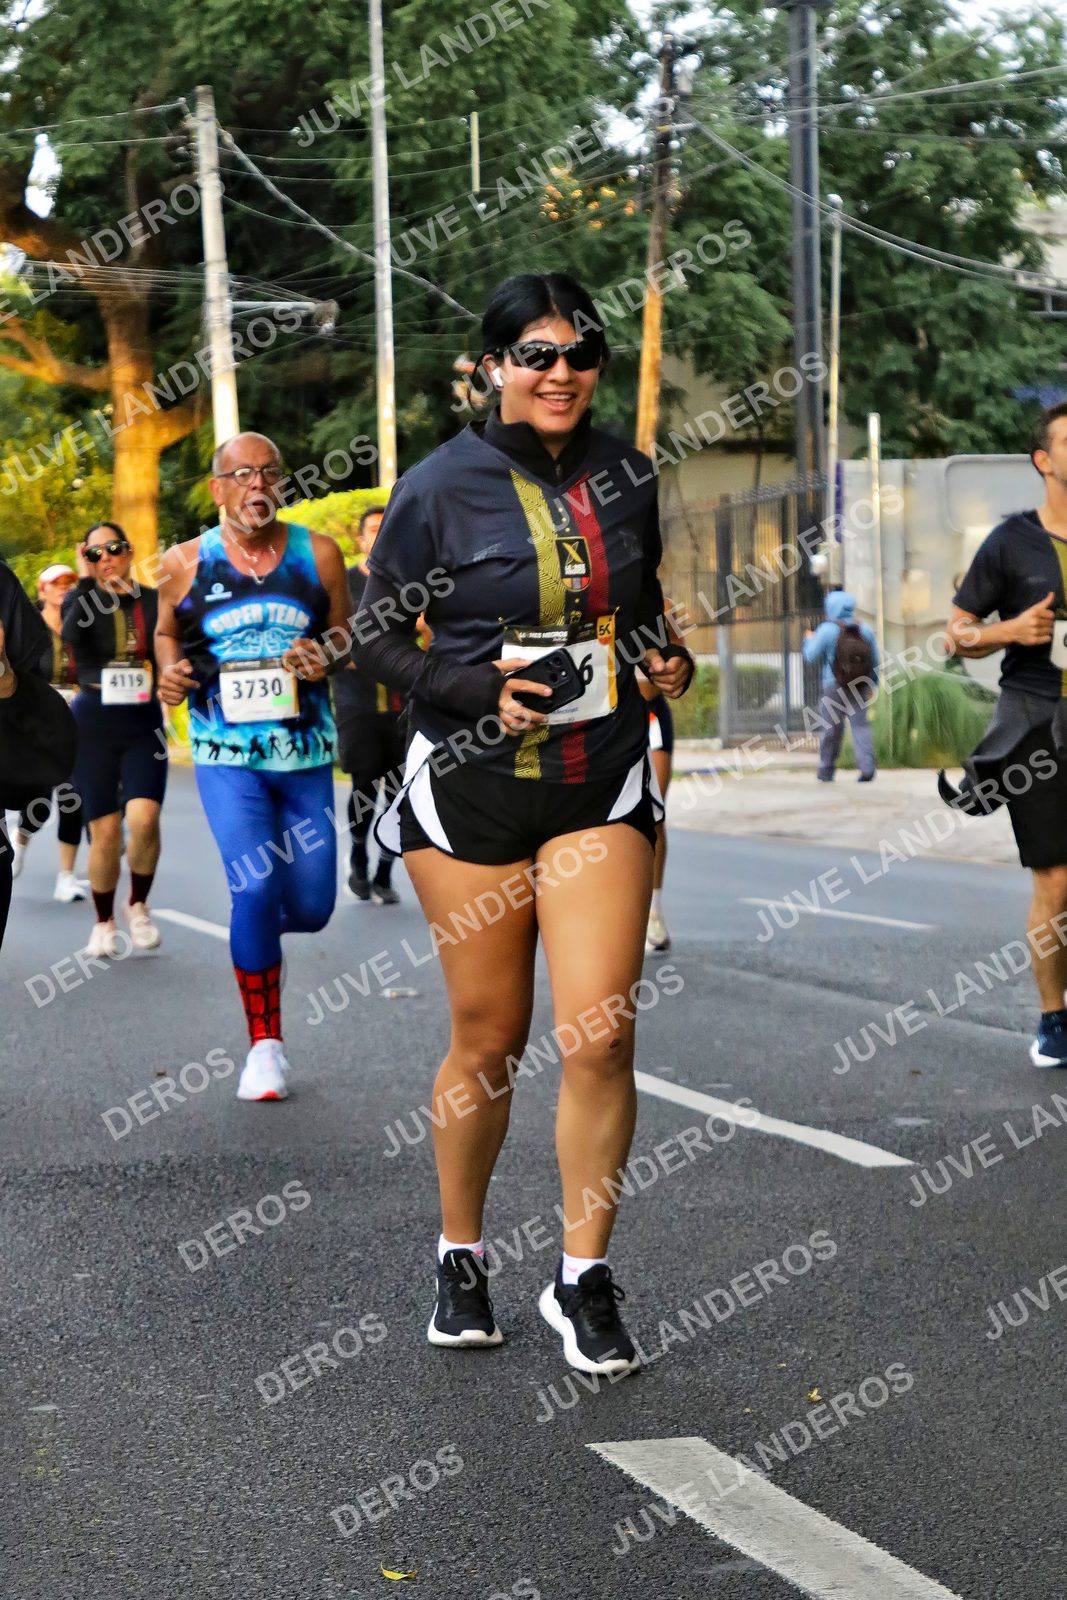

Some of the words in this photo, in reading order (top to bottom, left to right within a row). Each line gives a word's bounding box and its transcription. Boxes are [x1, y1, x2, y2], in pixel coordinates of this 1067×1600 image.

[210, 603, 262, 634] SUPER
[266, 602, 310, 630] TEAM
[599, 624, 611, 636] 5K
[110, 674, 144, 688] 4119
[232, 677, 282, 700] 3730
